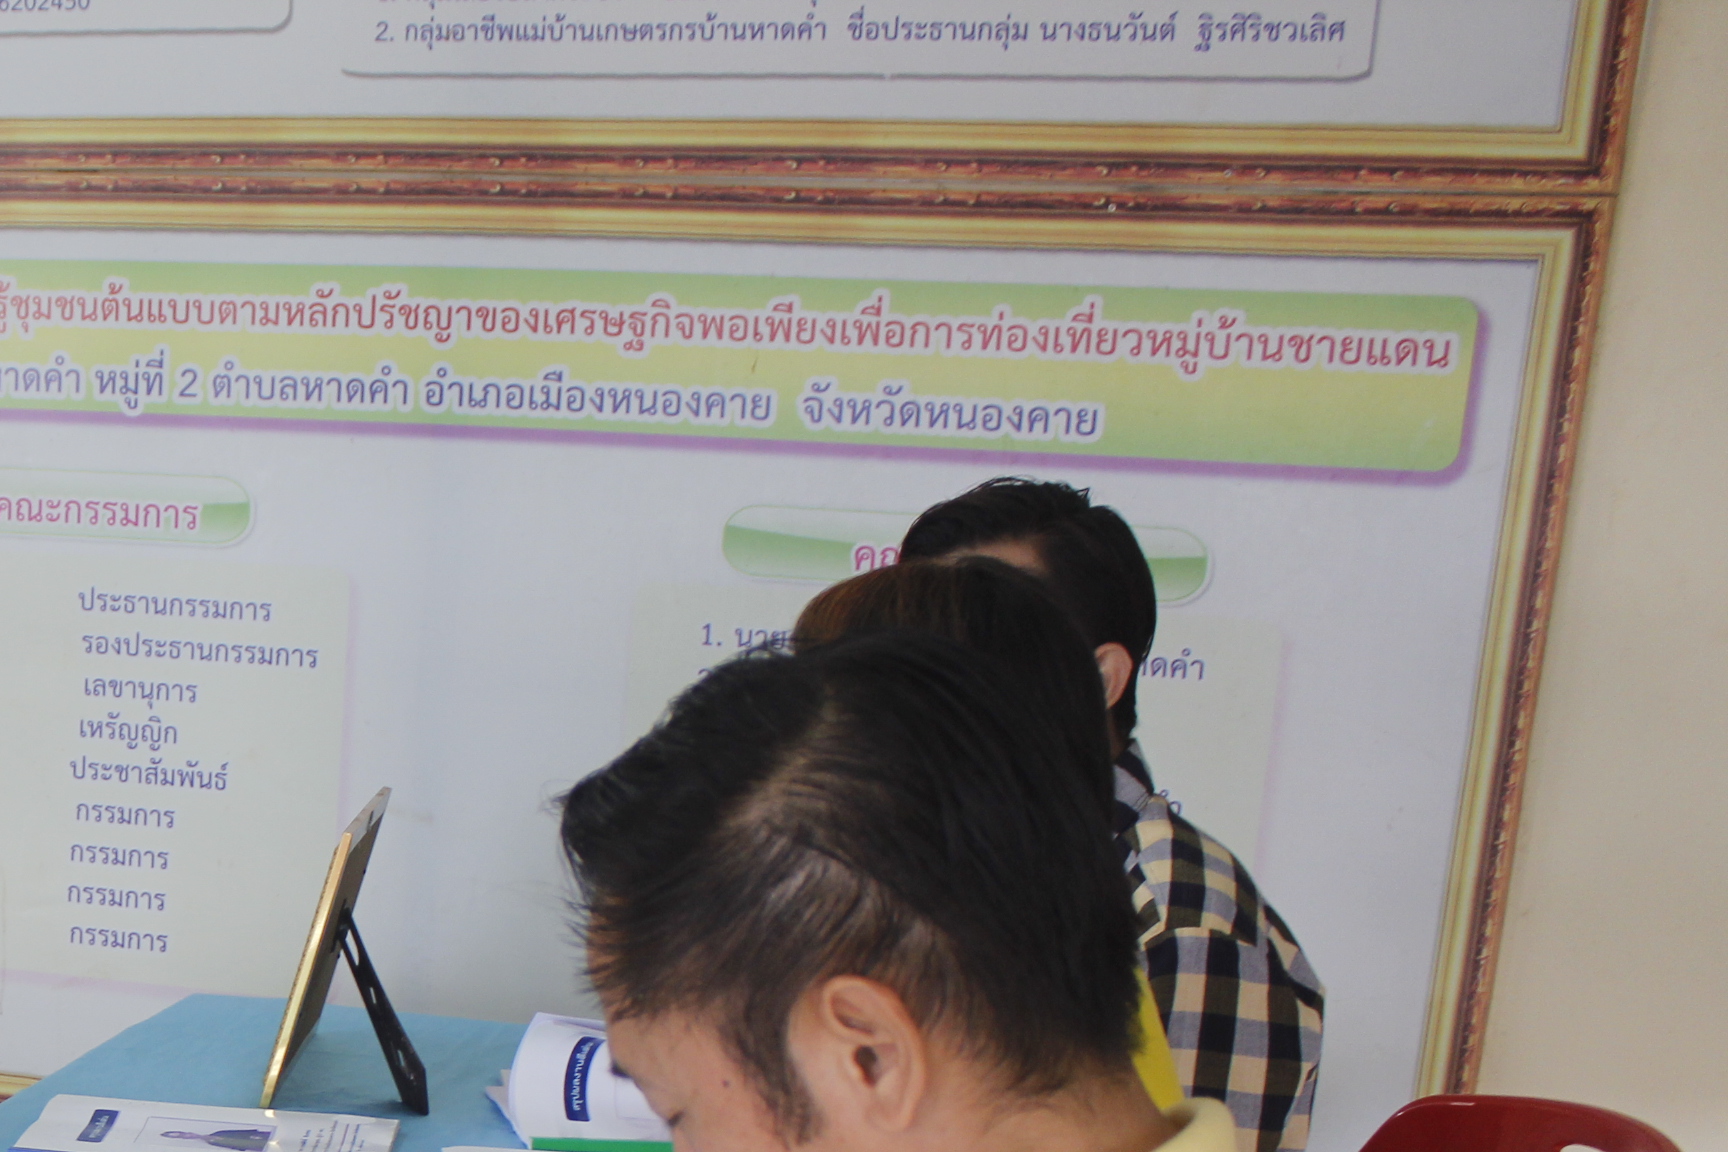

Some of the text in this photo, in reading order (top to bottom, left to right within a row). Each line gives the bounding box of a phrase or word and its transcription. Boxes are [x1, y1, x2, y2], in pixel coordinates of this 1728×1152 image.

[375, 21, 394, 42] 2.
[847, 10, 1028, 52] ชื่อประธานกลุ่ม
[95, 349, 164, 409] หมู่ที่
[179, 369, 197, 397] 2
[213, 361, 408, 405] ตำบลหาดคำ
[425, 364, 771, 421] อำเภอเมืองหนองคาย
[803, 382, 1097, 436] จังหวัดหนองคาย
[78, 587, 271, 622] ประธานกรรมการ
[82, 632, 318, 668] รองประธานกรรมการ
[701, 622, 723, 647] 1.
[85, 678, 197, 710] เลขานุการ
[80, 712, 177, 751] เหรัญญิก
[70, 755, 228, 791] ประชาสัมพันธ์
[76, 803, 175, 828] กรรมการ
[71, 844, 169, 870] กรรมการ
[68, 885, 166, 911] กรรมการ
[70, 926, 168, 952] กรรมการ
